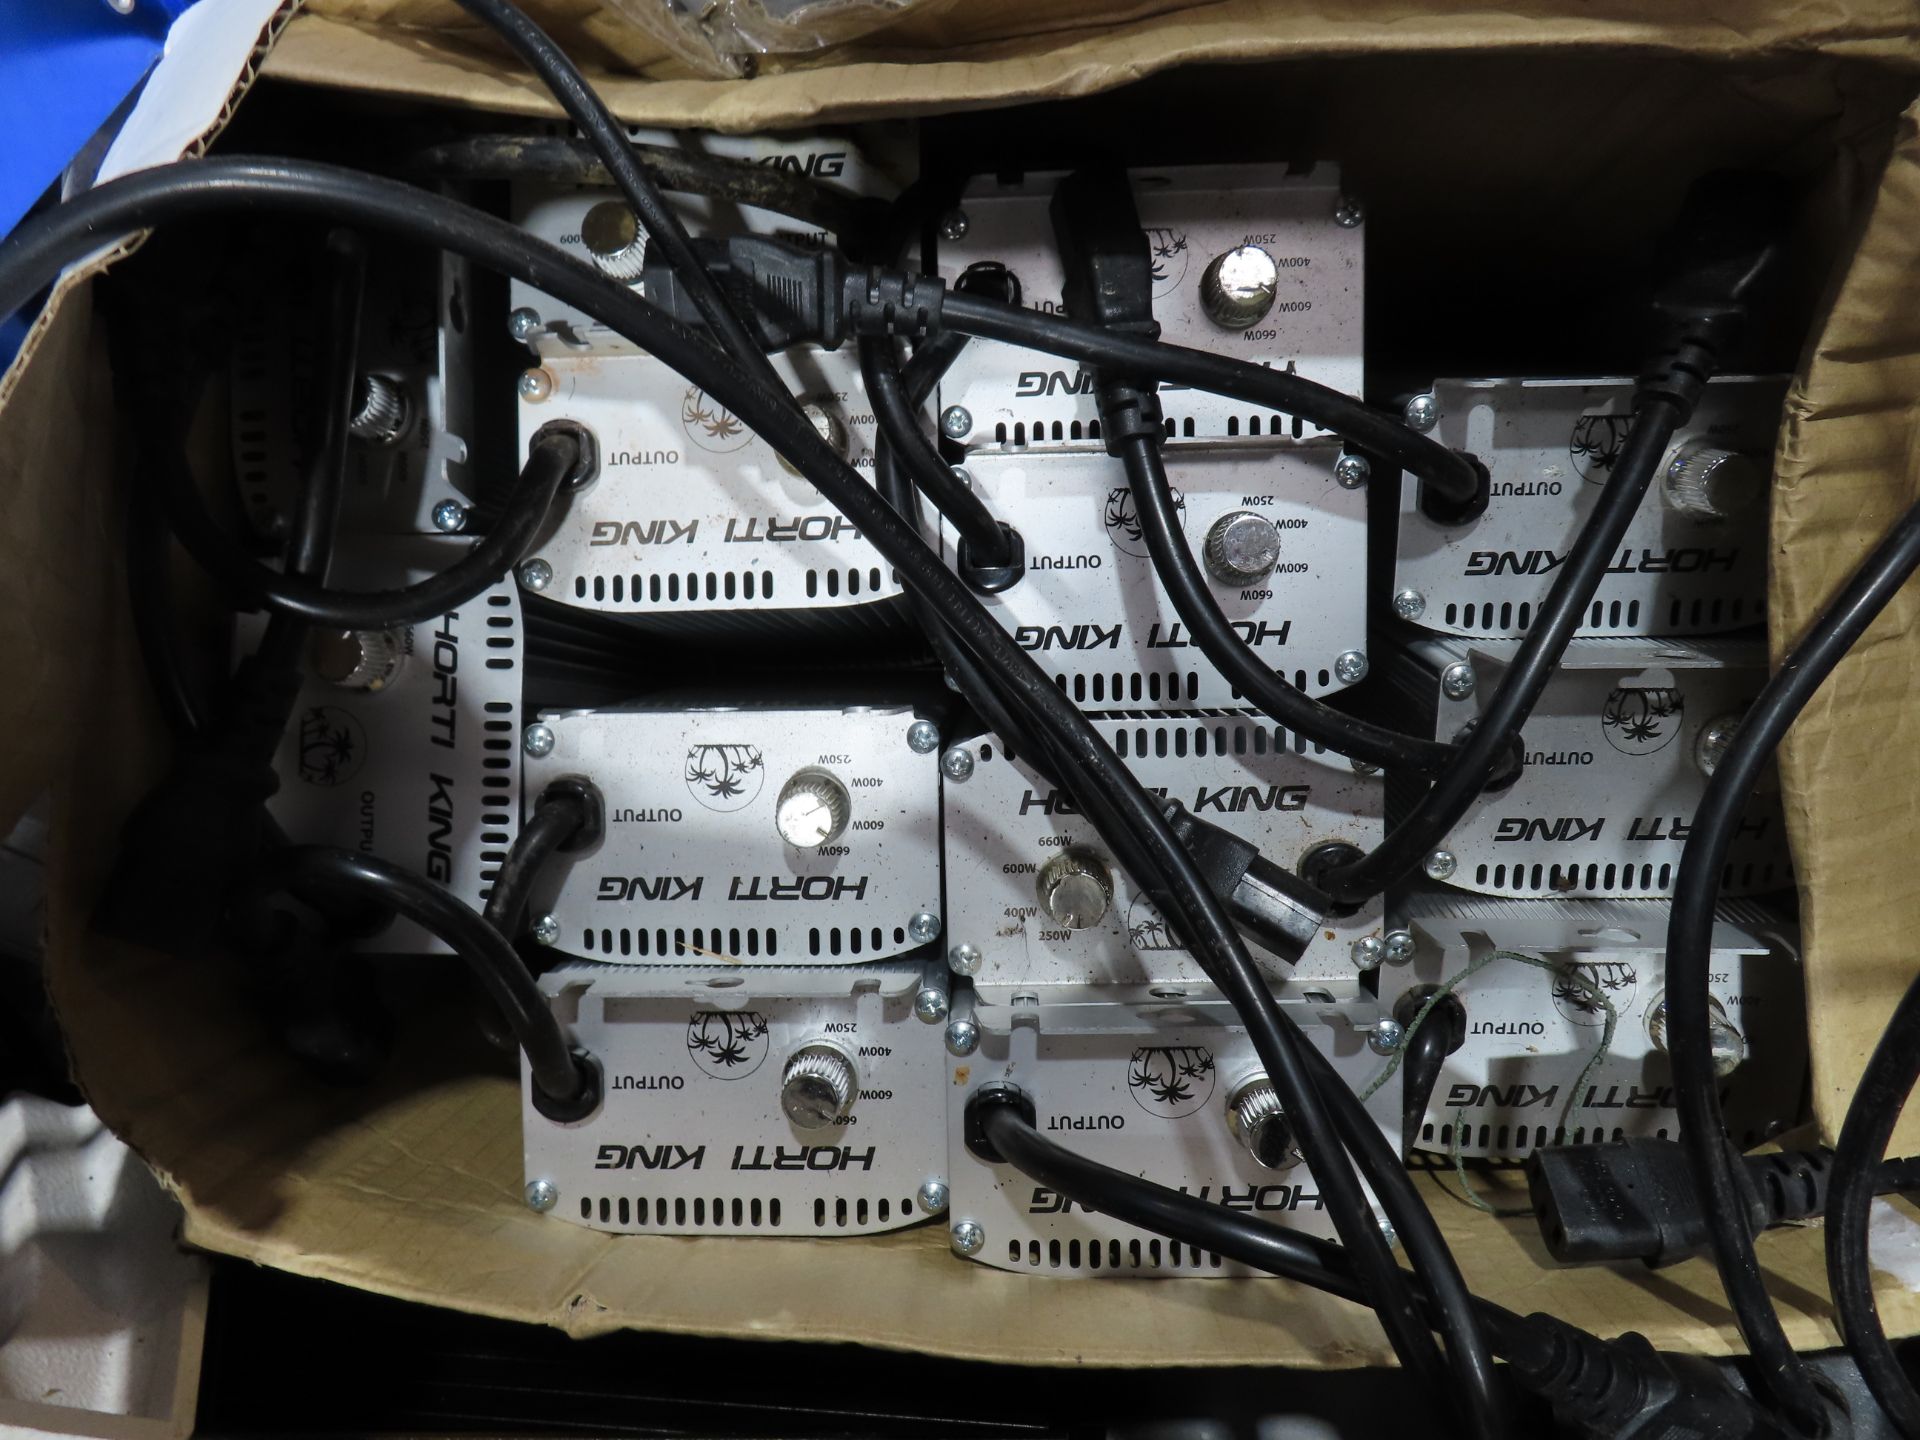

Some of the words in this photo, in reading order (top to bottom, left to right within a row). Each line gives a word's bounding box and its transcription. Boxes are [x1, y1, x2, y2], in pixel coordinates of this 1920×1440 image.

[560, 234, 581, 245] 600
[1243, 233, 1277, 245] 250W
[1277, 256, 1311, 268] 400W
[1278, 301, 1312, 313] 600W
[1243, 329, 1277, 342] 660W
[1015, 371, 1096, 398] ING
[849, 415, 879, 426] 00W
[608, 450, 679, 466] OUTPUT
[850, 457, 876, 468] 00W
[1490, 481, 1562, 497] OUTPUT
[1241, 495, 1275, 507] 250W
[1275, 518, 1309, 530] 400W
[590, 519, 700, 546] KING
[1029, 554, 1102, 571] OUTPUT
[1275, 562, 1309, 574] 600W
[1601, 549, 1739, 574] HORT
[1240, 589, 1274, 601] 660W
[1015, 623, 1123, 651] KING
[1147, 620, 1292, 649] HOTI
[431, 610, 460, 750] HORTI
[817, 753, 852, 765] 250W
[1523, 751, 1594, 766] OUTPUT
[851, 776, 884, 788] 400W
[1193, 784, 1310, 813] KING
[358, 790, 375, 853] OUTPU
[612, 807, 683, 823] OUTPUT
[426, 772, 454, 884] KING
[851, 820, 885, 831] 600W
[1493, 817, 1606, 842] KING
[1626, 817, 1770, 842] HRTI
[1038, 835, 1072, 848] 660W
[817, 845, 851, 857] 660W
[1002, 862, 1037, 875] 600W
[596, 876, 704, 901] KING
[727, 875, 869, 901] HORTI
[1003, 906, 1037, 918] 400W
[1038, 931, 1072, 942] 250W
[1703, 973, 1730, 984] 250
[824, 1022, 858, 1034] 250W
[1470, 1021, 1545, 1035] OUTPUT
[858, 1046, 892, 1058] 400W
[611, 1074, 685, 1091] OUTPUT
[859, 1089, 893, 1101] 600W
[1445, 1084, 1559, 1108] KING
[832, 1115, 858, 1127] 660
[1047, 1114, 1125, 1131] OUTPUT
[594, 1144, 706, 1170] KING
[730, 1145, 876, 1171] HORTI
